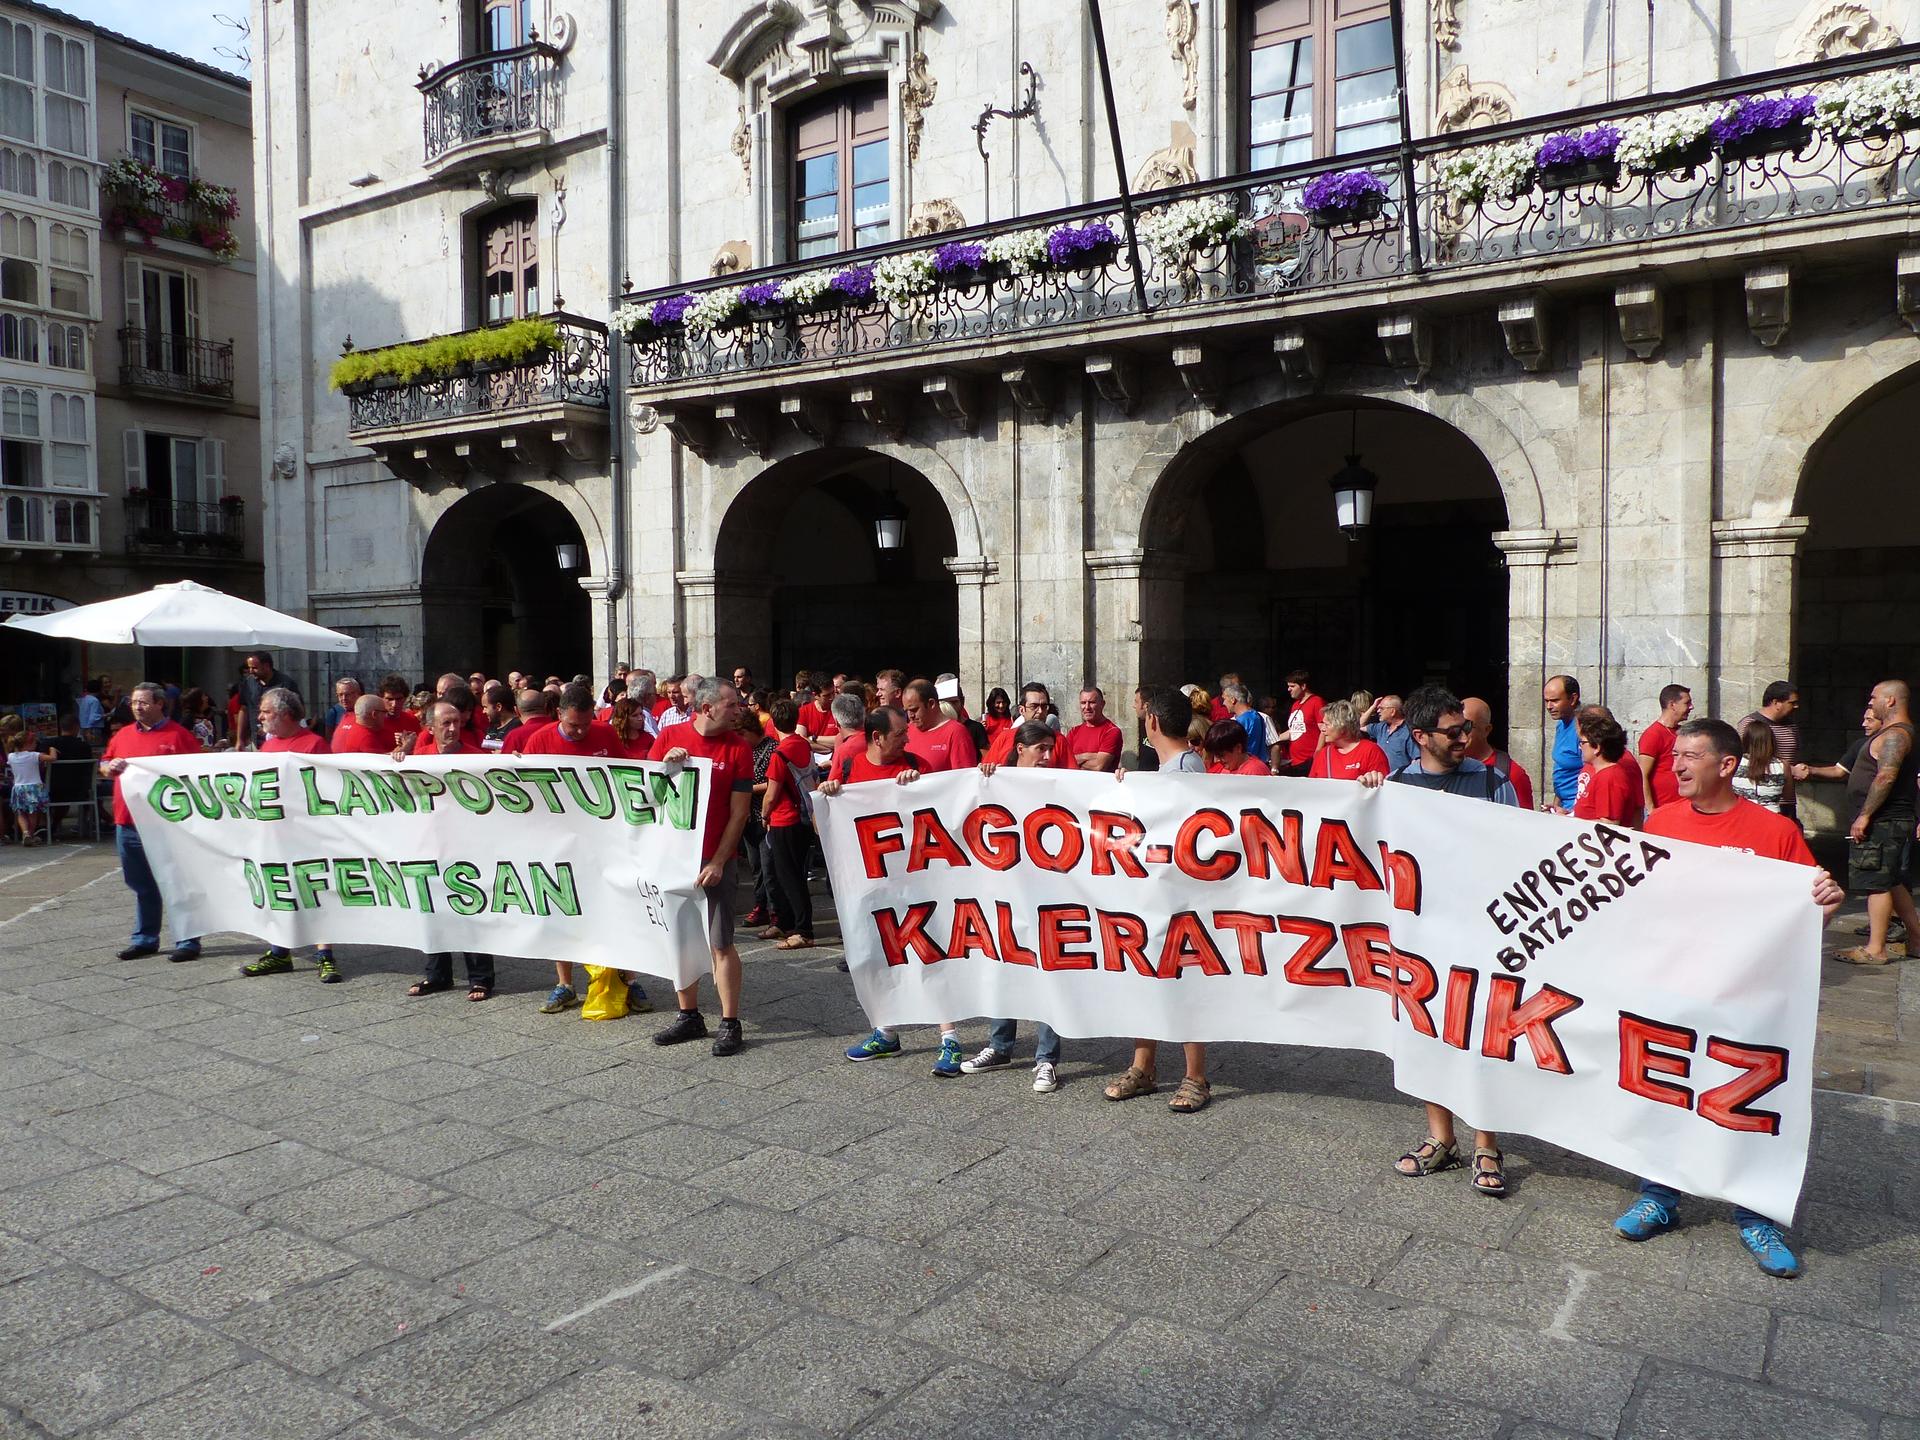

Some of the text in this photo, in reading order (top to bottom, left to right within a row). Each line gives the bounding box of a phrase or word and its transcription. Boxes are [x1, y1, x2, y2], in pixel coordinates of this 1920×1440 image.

[147, 764, 700, 832] GURE LANPOSTUEN
[243, 857, 583, 917] DEFENTSAN
[1486, 822, 1631, 936] ENPRESA
[1496, 839, 1672, 973] BATZORDEA
[871, 897, 1790, 1137] KALERATZERIK EZ
